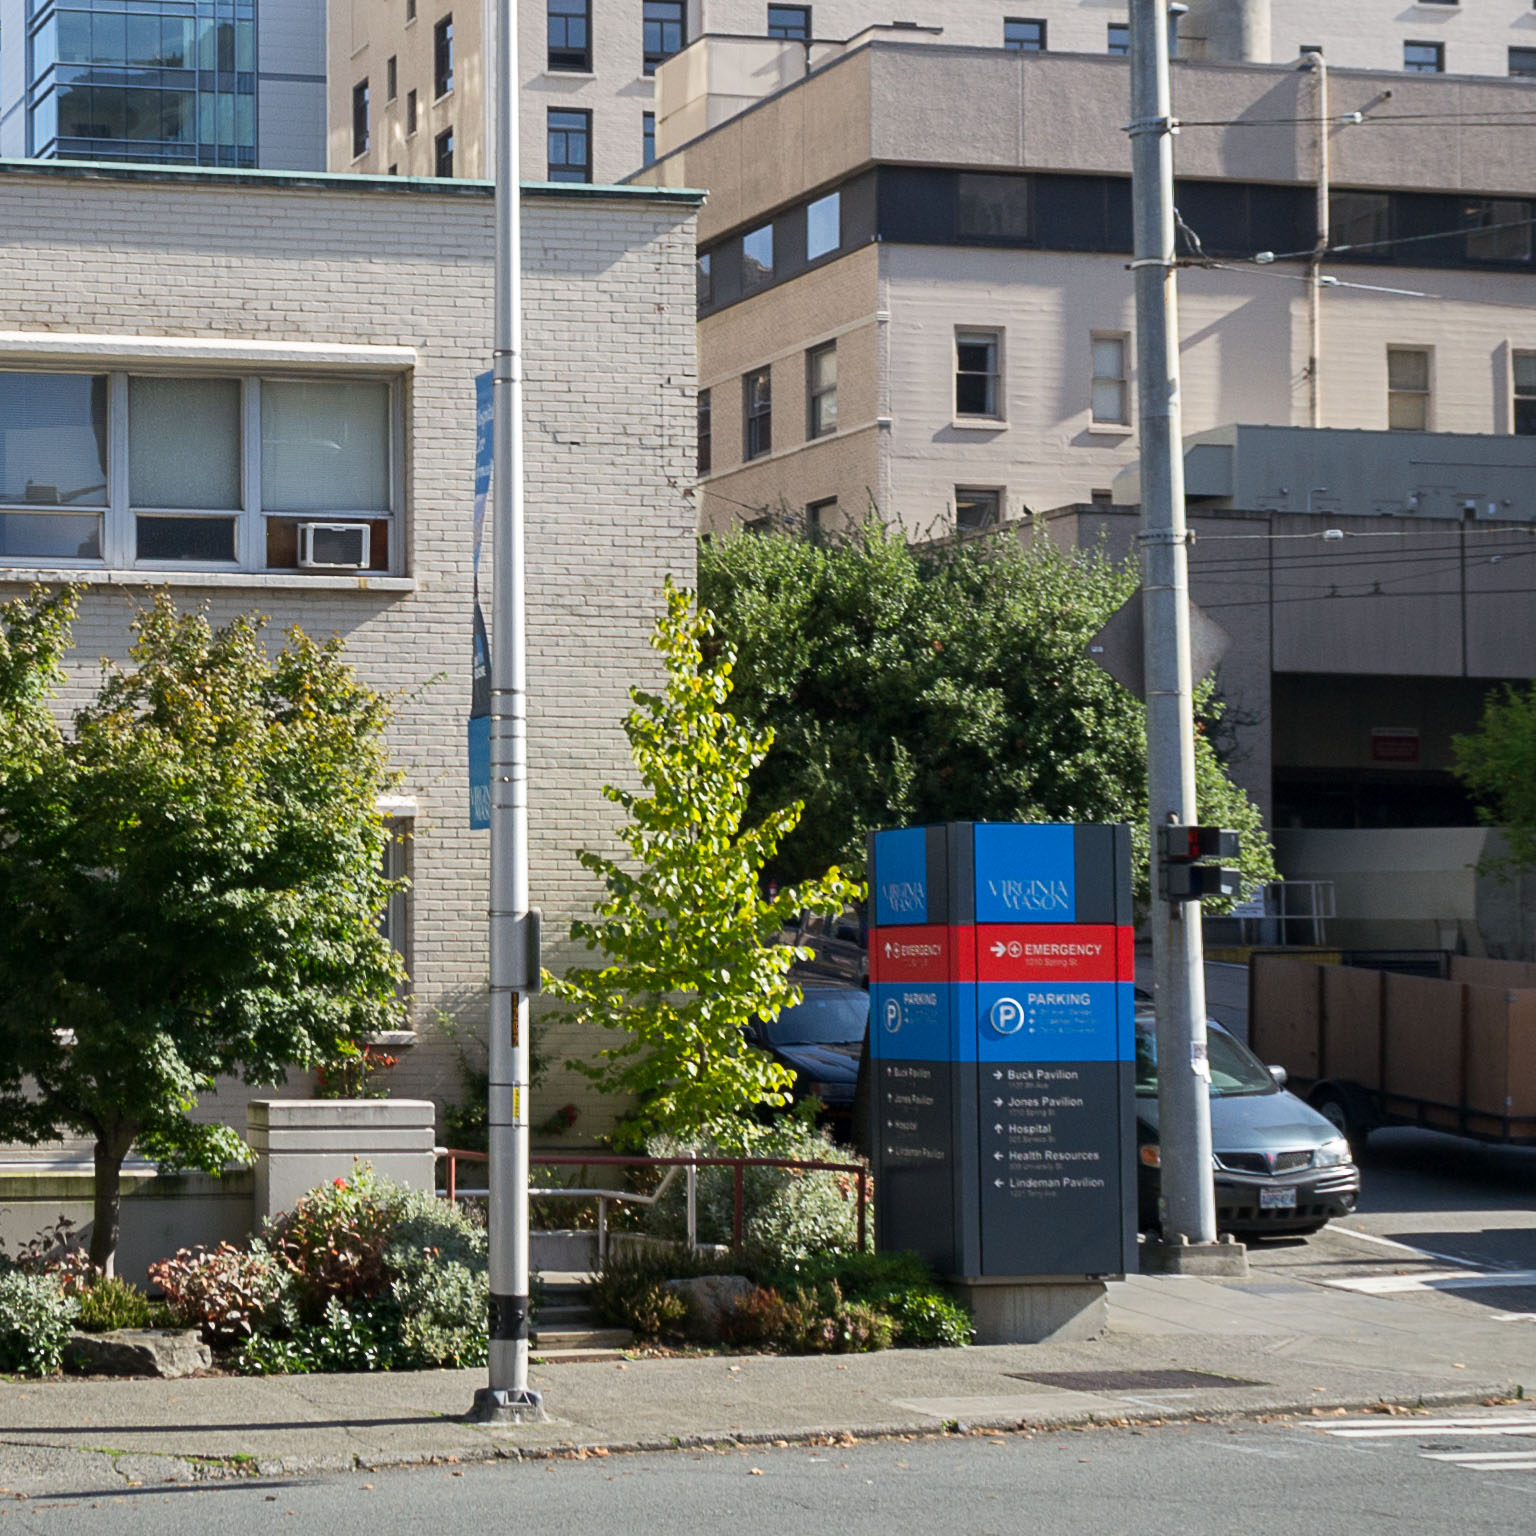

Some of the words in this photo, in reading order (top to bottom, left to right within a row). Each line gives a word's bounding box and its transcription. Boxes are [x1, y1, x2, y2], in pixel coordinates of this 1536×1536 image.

[988, 880, 1068, 897] VIRGINIA
[1002, 894, 1069, 910] MASON
[901, 944, 942, 957] EMERGENCY
[1025, 944, 1102, 956] EMERGENCY
[903, 992, 937, 1006] PARKING
[1028, 993, 1091, 1005] PARKING
[1007, 1070, 1034, 1080] Buck
[1037, 1069, 1079, 1080] Pavilion
[1008, 1097, 1039, 1107] Jones
[1042, 1096, 1084, 1107] Pavilion
[1008, 1124, 1051, 1135] Hospital
[1009, 1151, 1042, 1161] Health
[1045, 1151, 1100, 1161] Resources
[1009, 1178, 1060, 1188] Lindeman
[1063, 1177, 1105, 1188] Pavilion
